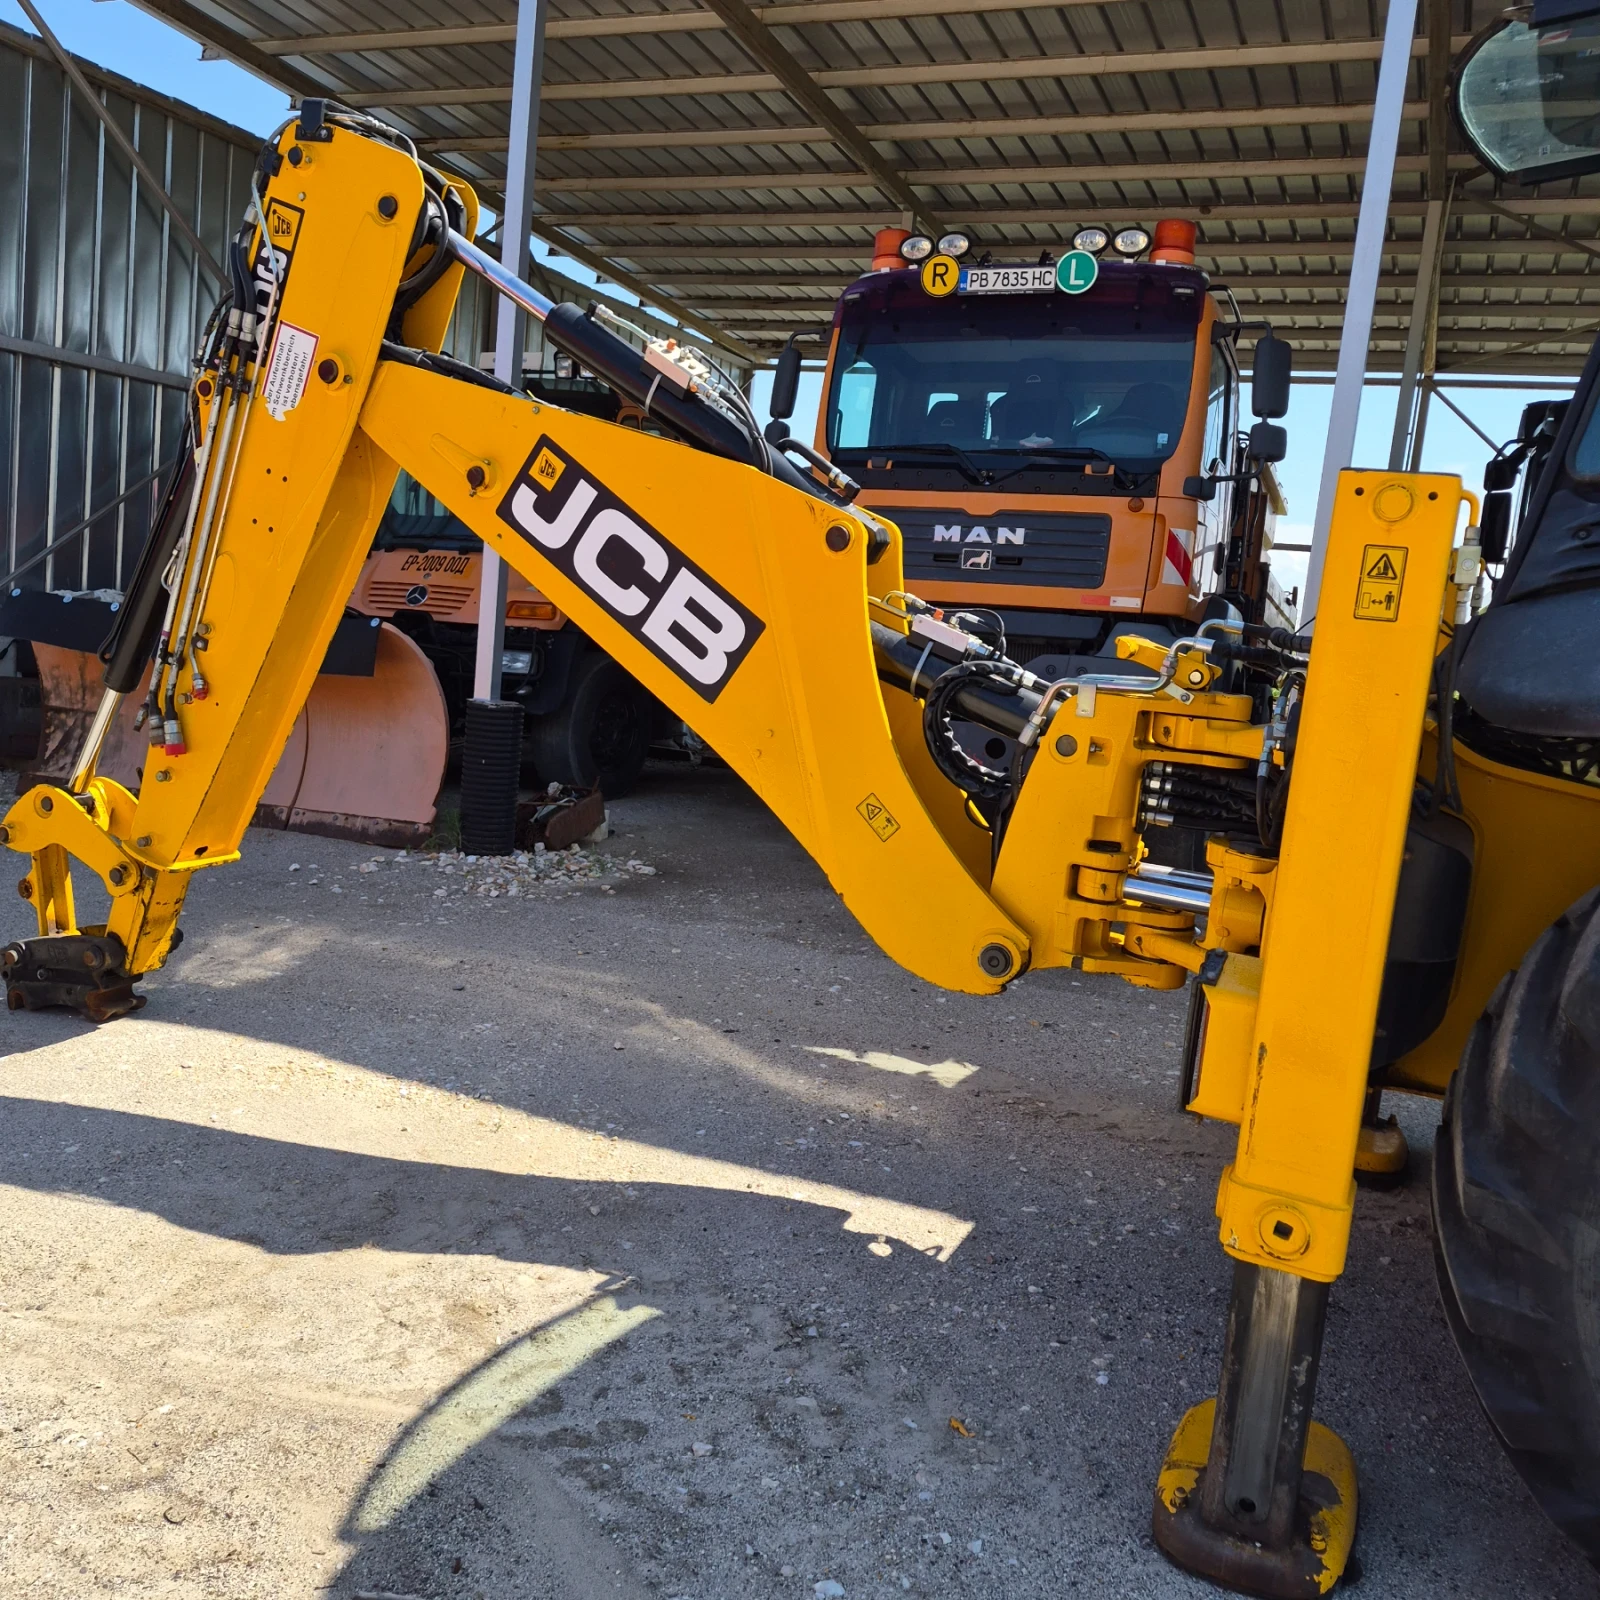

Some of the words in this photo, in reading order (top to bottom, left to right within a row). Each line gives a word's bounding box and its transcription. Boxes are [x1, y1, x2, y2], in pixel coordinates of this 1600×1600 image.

[274, 215, 292, 235] JCB
[932, 262, 949, 288] R
[969, 272, 989, 288] PB
[991, 270, 1029, 288] 7835
[1031, 269, 1053, 287] HC
[1069, 258, 1085, 286] L
[270, 341, 286, 387] Aufenthalt
[273, 334, 296, 405] Schwenkbereich
[286, 352, 300, 393] verboten!
[290, 351, 309, 409] ebensgefahr!
[540, 458, 556, 478] JCB
[933, 524, 1026, 545] MAN
[511, 478, 746, 685] JCB
